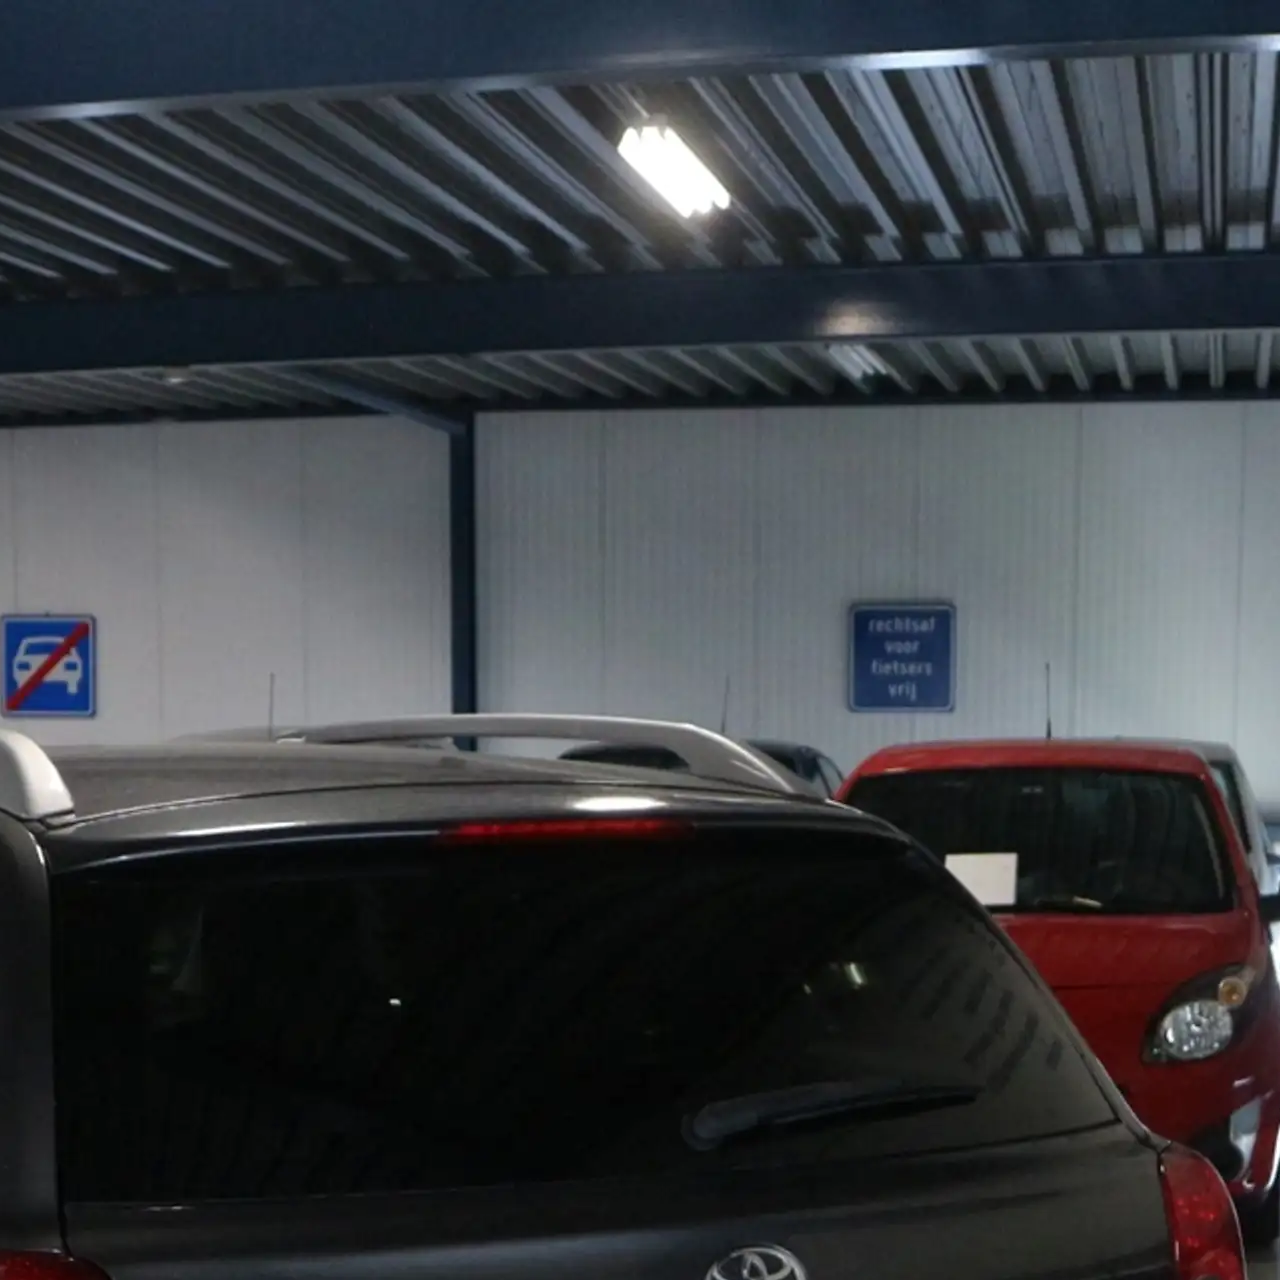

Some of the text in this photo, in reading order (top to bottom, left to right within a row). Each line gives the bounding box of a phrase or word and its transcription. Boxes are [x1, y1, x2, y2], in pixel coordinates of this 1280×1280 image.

[867, 616, 936, 633] rechtsaf
[884, 640, 920, 654] voor
[871, 659, 933, 676] fietsers
[887, 681, 918, 701] vrij
